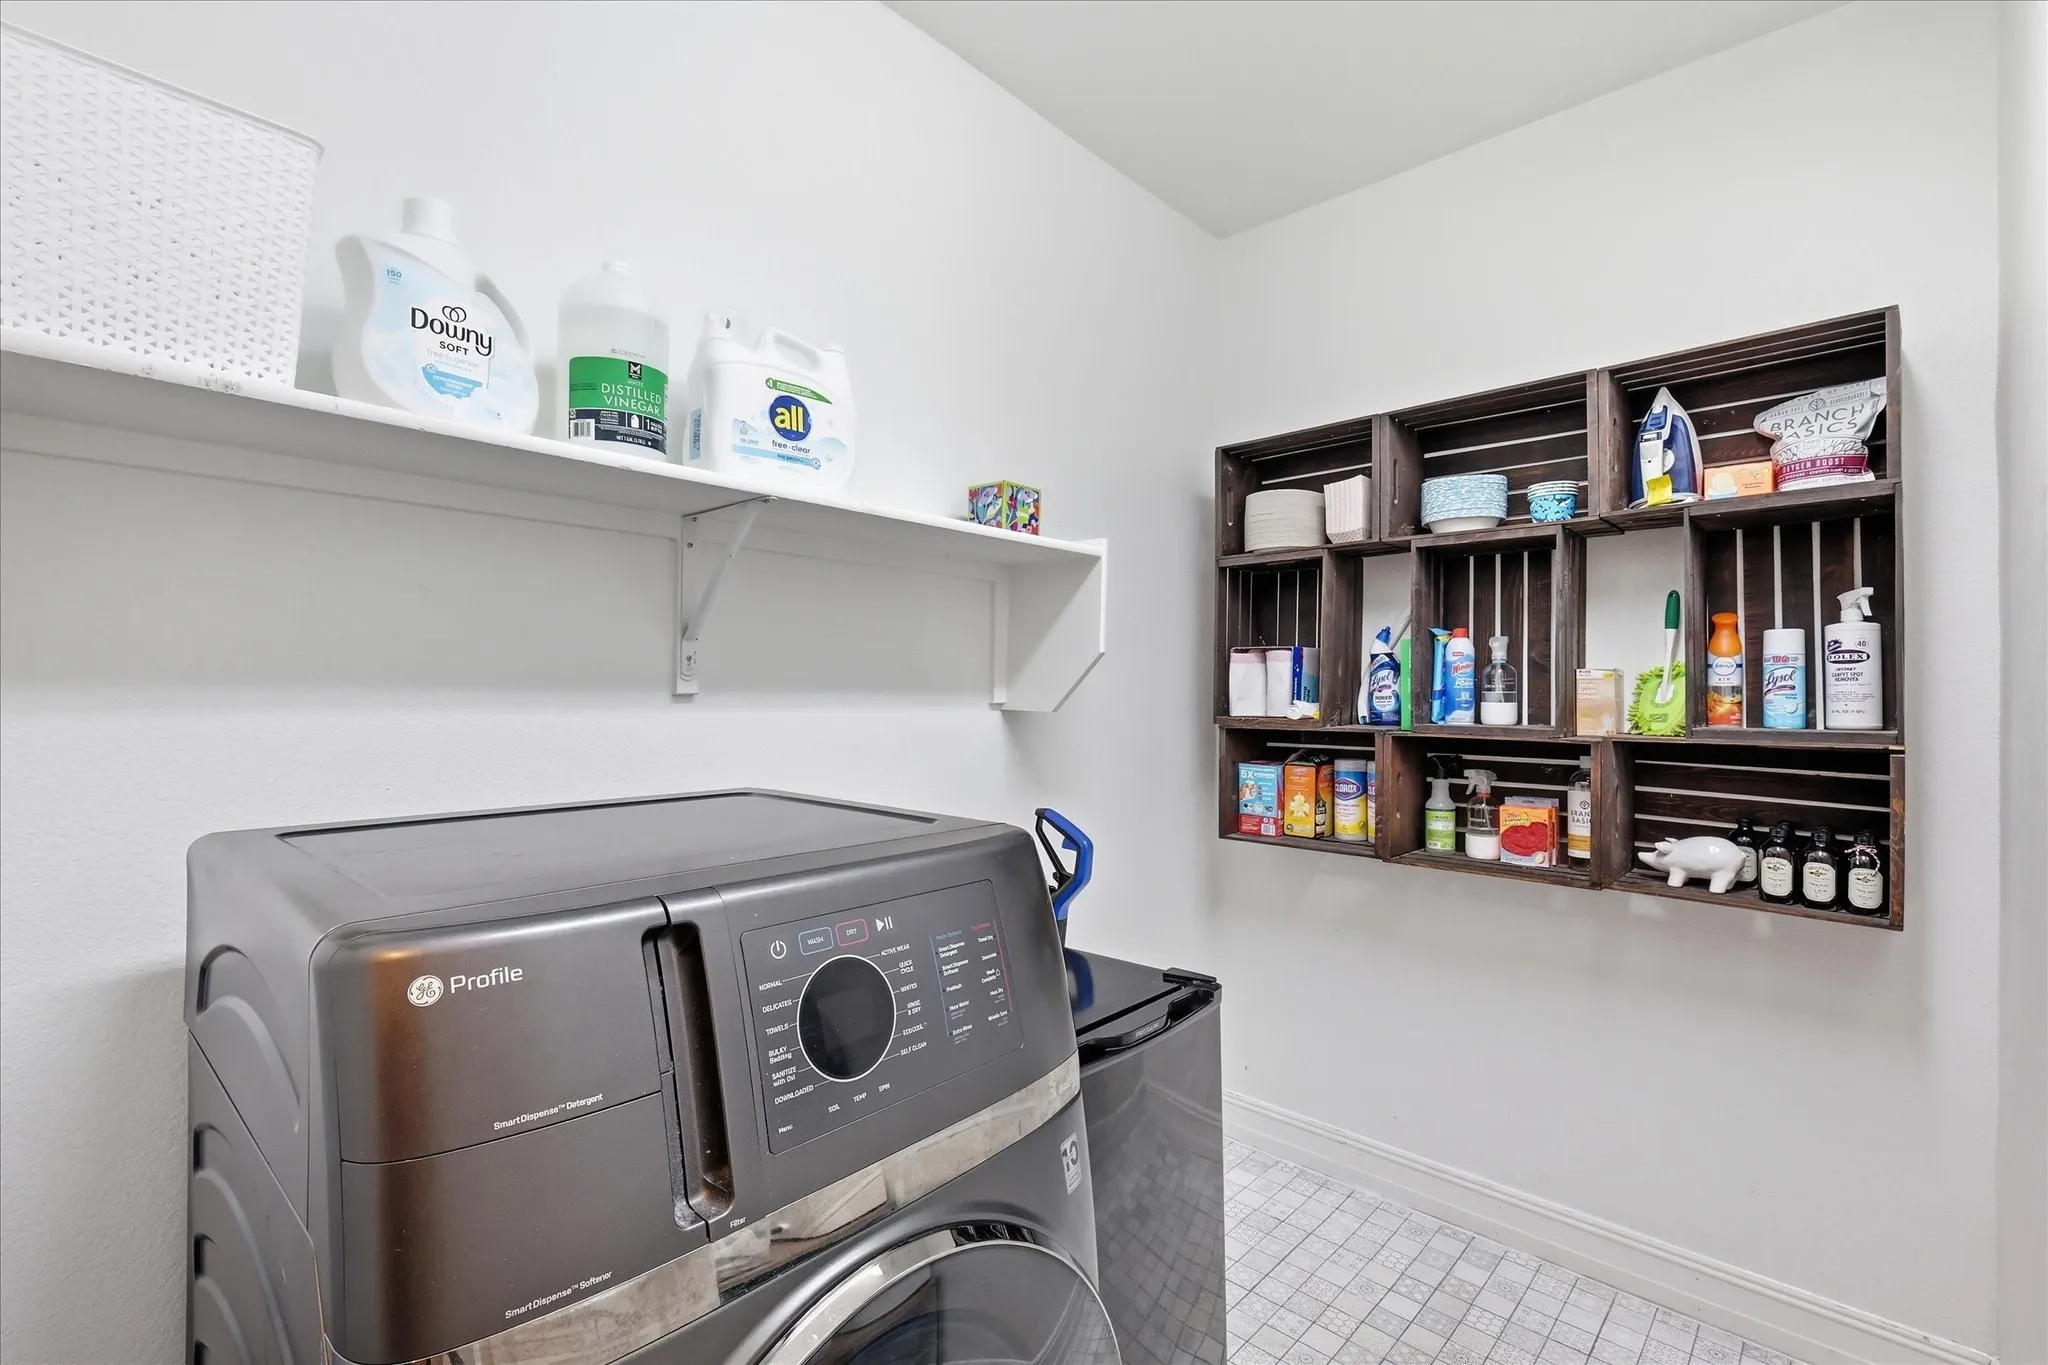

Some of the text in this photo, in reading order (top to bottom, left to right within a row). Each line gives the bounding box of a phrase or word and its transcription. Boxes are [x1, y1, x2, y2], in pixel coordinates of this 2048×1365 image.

[386, 268, 402, 279] 150
[411, 307, 492, 357] Downy
[439, 340, 469, 356] SOFT
[601, 382, 661, 405] DISTILLED
[604, 395, 661, 416] VINEGAR
[774, 405, 804, 433] all
[1770, 404, 1865, 432] BRANCH
[1774, 418, 1858, 440] BASICS
[772, 440, 811, 455] free clear
[1816, 457, 1845, 467] BOOST
[1371, 670, 1392, 687] Lysol
[1765, 669, 1797, 689] Lysol
[1240, 769, 1255, 779] 5X
[1335, 783, 1357, 793] CLOROX
[1570, 809, 1591, 817] BRAN
[1572, 816, 1591, 824] BASI
[845, 928, 857, 936] DRY
[807, 936, 824, 946] WASH
[450, 966, 524, 994] Profile
[759, 980, 783, 992] NORMAL
[762, 999, 792, 1013] DELICATES
[765, 1022, 789, 1036] TOWELS
[768, 1046, 788, 1058] BULKY
[769, 1052, 793, 1065] Bedding
[771, 1066, 797, 1080] SANITIZE
[773, 1076, 786, 1088] with
[879, 1082, 891, 1093] SPIN
[774, 1084, 814, 1105] DOWNLOADED
[853, 1092, 867, 1103] TEMP
[566, 1093, 604, 1110] Detergent
[828, 1103, 841, 1114] SOIL
[778, 1124, 794, 1134] Menu
[730, 1216, 747, 1229] Filter
[579, 1271, 613, 1290] Softener
